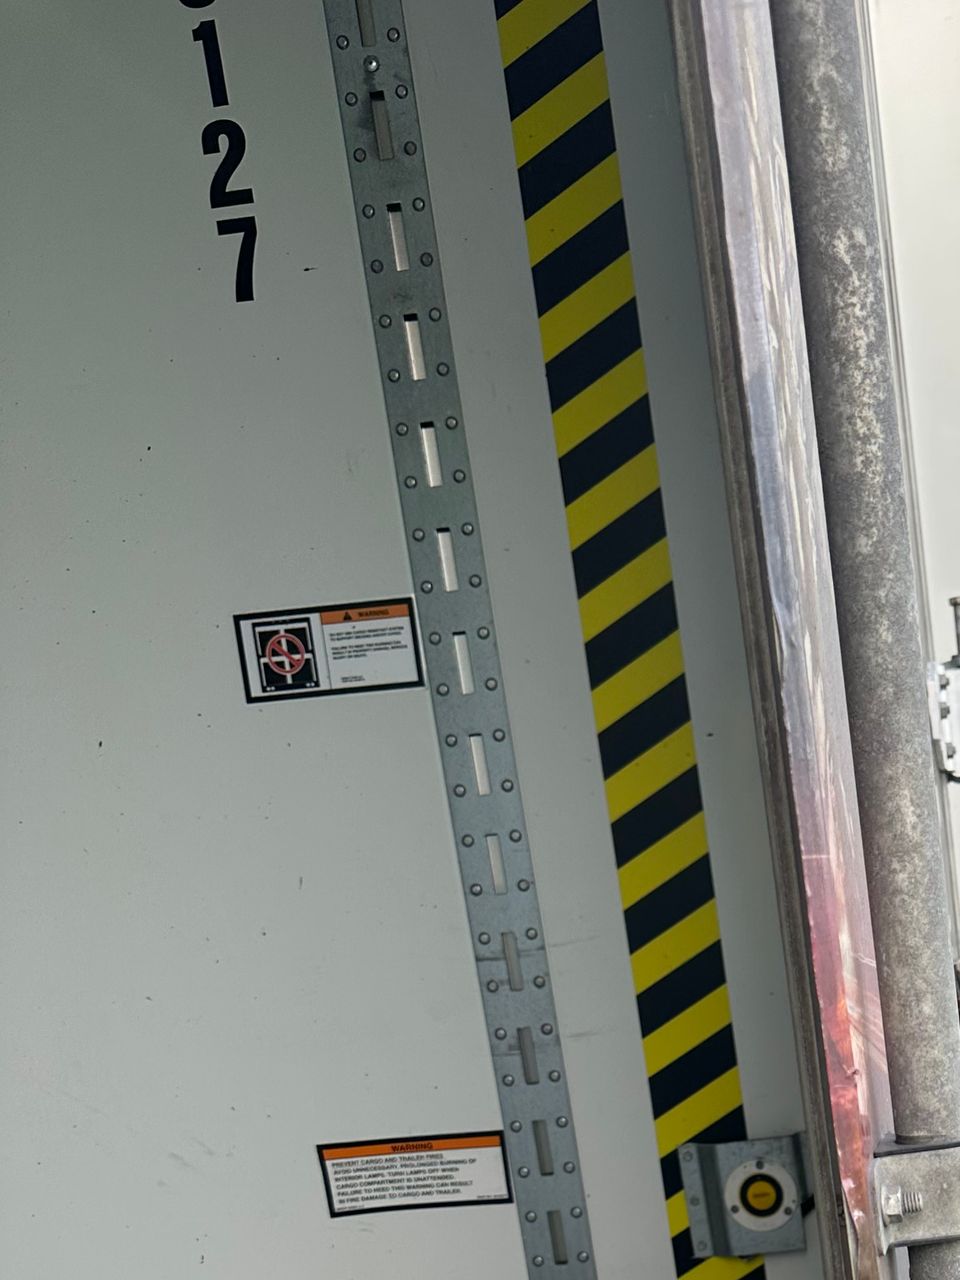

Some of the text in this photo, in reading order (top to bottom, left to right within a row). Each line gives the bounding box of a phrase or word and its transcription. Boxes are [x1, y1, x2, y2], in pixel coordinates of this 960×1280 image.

[179, 0, 258, 302] 127
[358, 608, 390, 618] WARNING
[391, 1142, 433, 1152] WARNING
